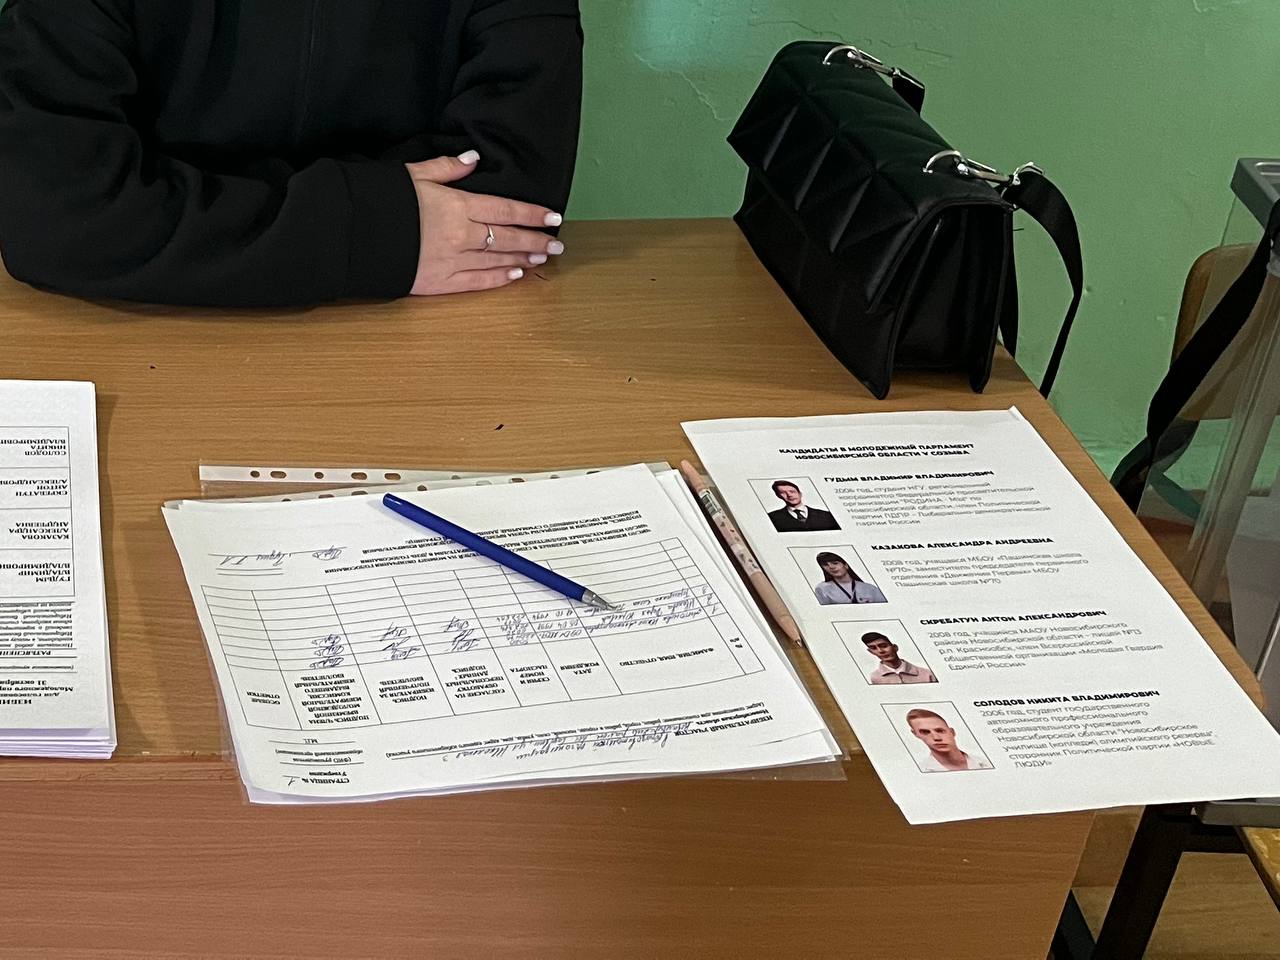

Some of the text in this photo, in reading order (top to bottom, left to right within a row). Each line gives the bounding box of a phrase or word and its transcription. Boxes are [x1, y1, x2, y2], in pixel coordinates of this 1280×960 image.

[848, 444, 917, 452] МОЛОДЕЖНЫЙ
[795, 452, 875, 460] НОВОСИБИРСКОЙ
[915, 471, 994, 479] ВЛАДИМИРОВИЧ
[927, 540, 993, 548] АЛЕКСАНДРА
[324, 563, 374, 573] ГОЛОСОВАНИЯ
[920, 617, 979, 625] СКРЕБАТУН
[1018, 610, 1107, 622] АЛЕКСАНДРОВИЧ
[560, 661, 600, 670] РОЖДЕНИЯ
[619, 657, 657, 667] ОТЧЕСТВО
[451, 665, 485, 673] ПОДПИСЬ
[509, 665, 548, 673] ПАСПОРТА
[300, 673, 344, 681] БЮЛЛЕТЕНЬ
[459, 670, 489, 678] ДАННЫХ
[294, 678, 355, 688] ИЗБИРАТЕЛЬНЫЙ
[379, 676, 424, 686] БЮЛЛЕТЕНЬ
[526, 676, 550, 684] СЕРИЯ
[305, 685, 350, 693] ВЫДАВШЕГО
[379, 682, 430, 693] ПОЛУЧЕННЫЙ
[457, 683, 498, 692] ОБРАБОТКУ
[246, 691, 280, 699] ОТМЕТКИ
[467, 688, 505, 697] СОГЛАСИЕ
[301, 696, 362, 706] ИЗБИРАТЕЛЬНОЙ
[392, 695, 427, 704] ПОДПИСЬ
[974, 690, 1160, 707] СОЛОДОВ НИКИТА ВЛАДИМИРОВИЧ
[308, 703, 360, 712] МОЛОДЕЖНОЙ
[1064, 702, 1150, 712] государственного
[314, 710, 359, 718] ВРЕМЕННОЙ
[1050, 711, 1148, 722] профессионального
[335, 715, 370, 723] ПОДПИСЬ
[709, 715, 773, 732] ИЗБИРАТЕЛЬНЫЙ
[674, 726, 708, 736] УЧАСТОК
[992, 724, 1081, 734] образовательного
[997, 733, 1076, 742] Новосибирской
[1063, 746, 1134, 755] Политической
